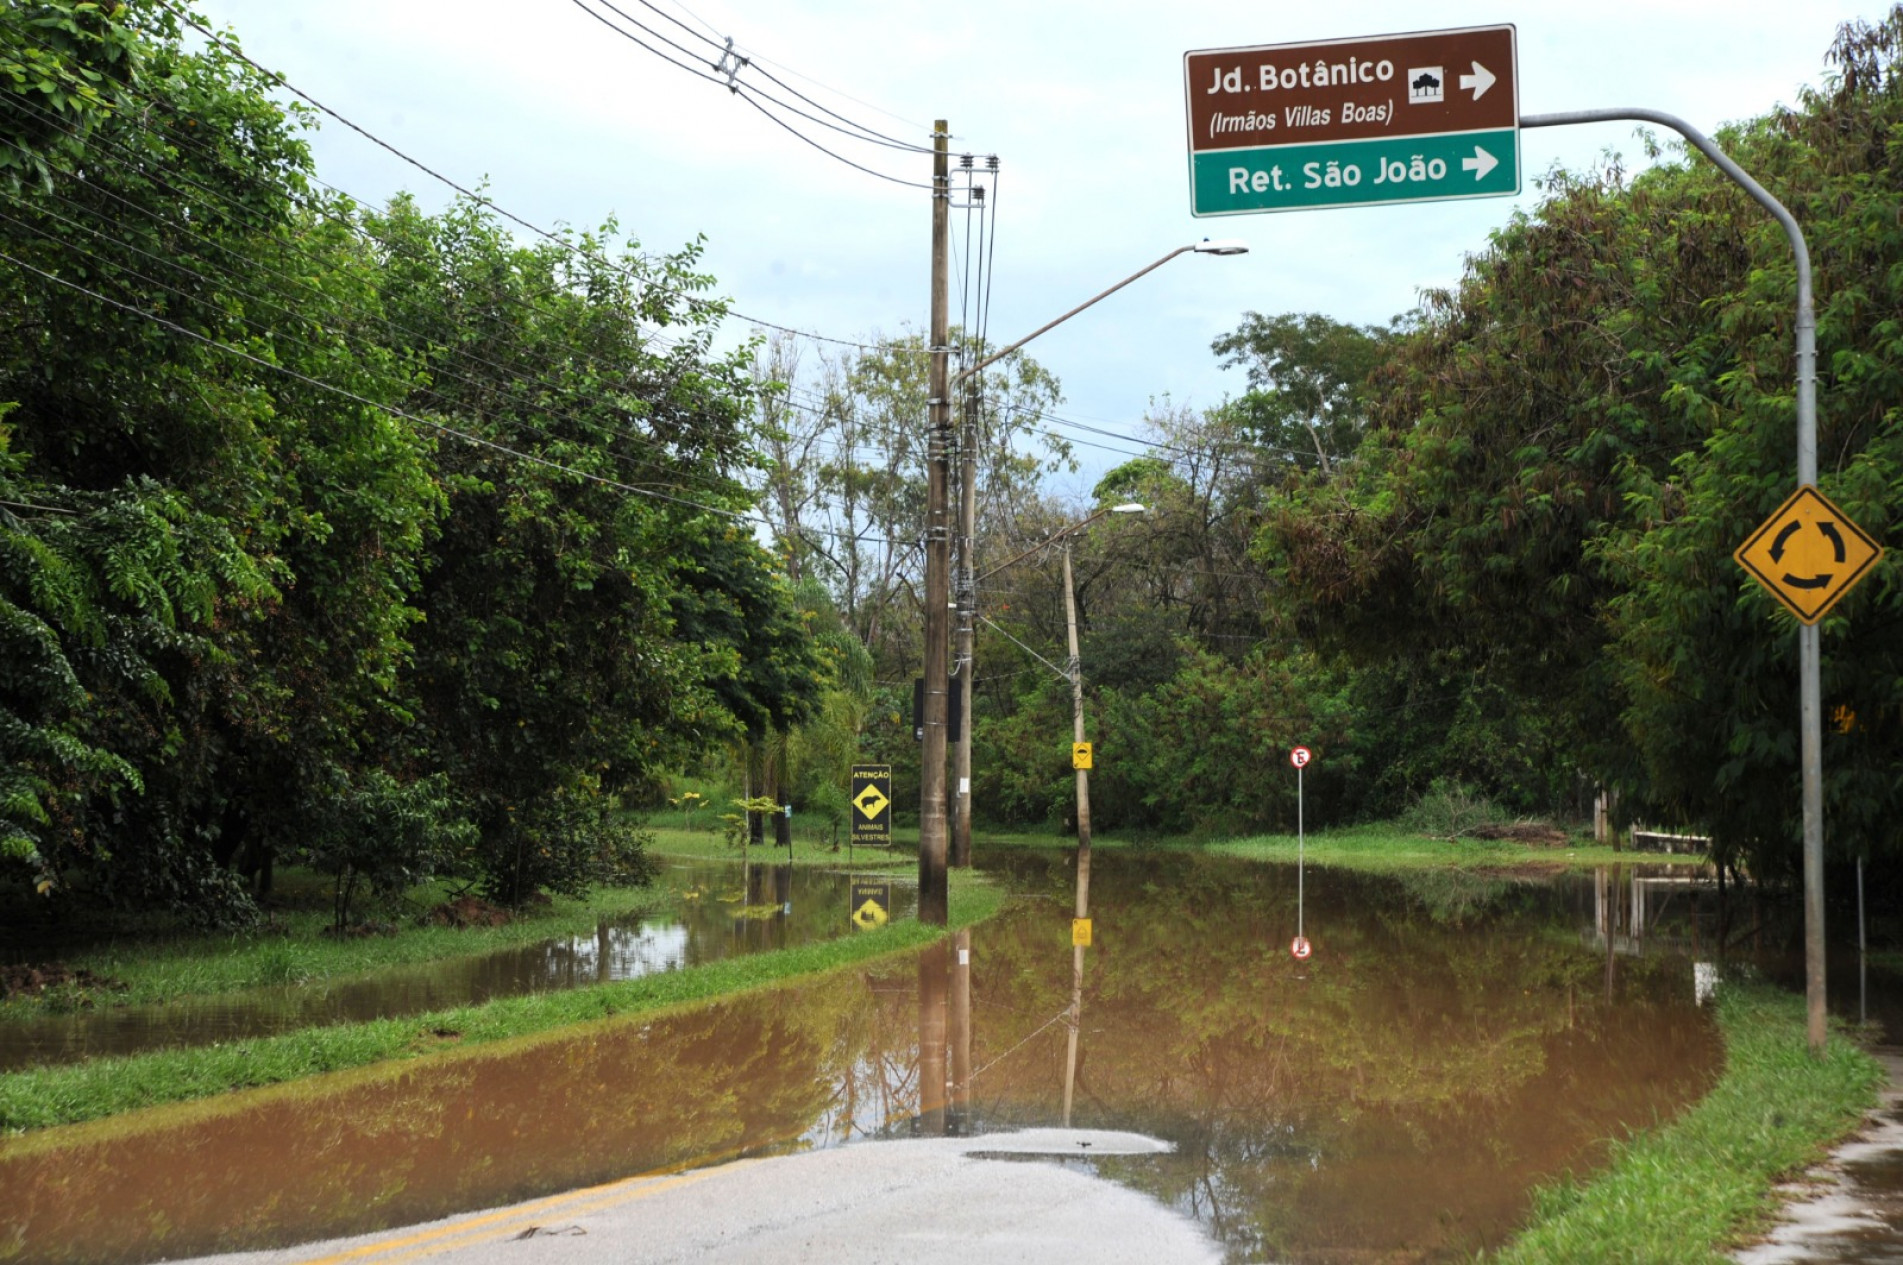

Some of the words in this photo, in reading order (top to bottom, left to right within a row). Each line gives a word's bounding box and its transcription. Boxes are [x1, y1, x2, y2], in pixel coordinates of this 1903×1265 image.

[1207, 66, 1251, 95] Jd.
[1260, 57, 1395, 91] Botânico
[1210, 110, 1276, 138] (Irmãos
[1285, 107, 1331, 127] Villas
[1341, 99, 1394, 126] Boas)
[1228, 164, 1292, 194] Ret.
[1303, 160, 1362, 189] São
[1374, 154, 1447, 185] João
[853, 770, 889, 780] ATENÇÃO
[858, 823, 883, 831] ANIMAIS
